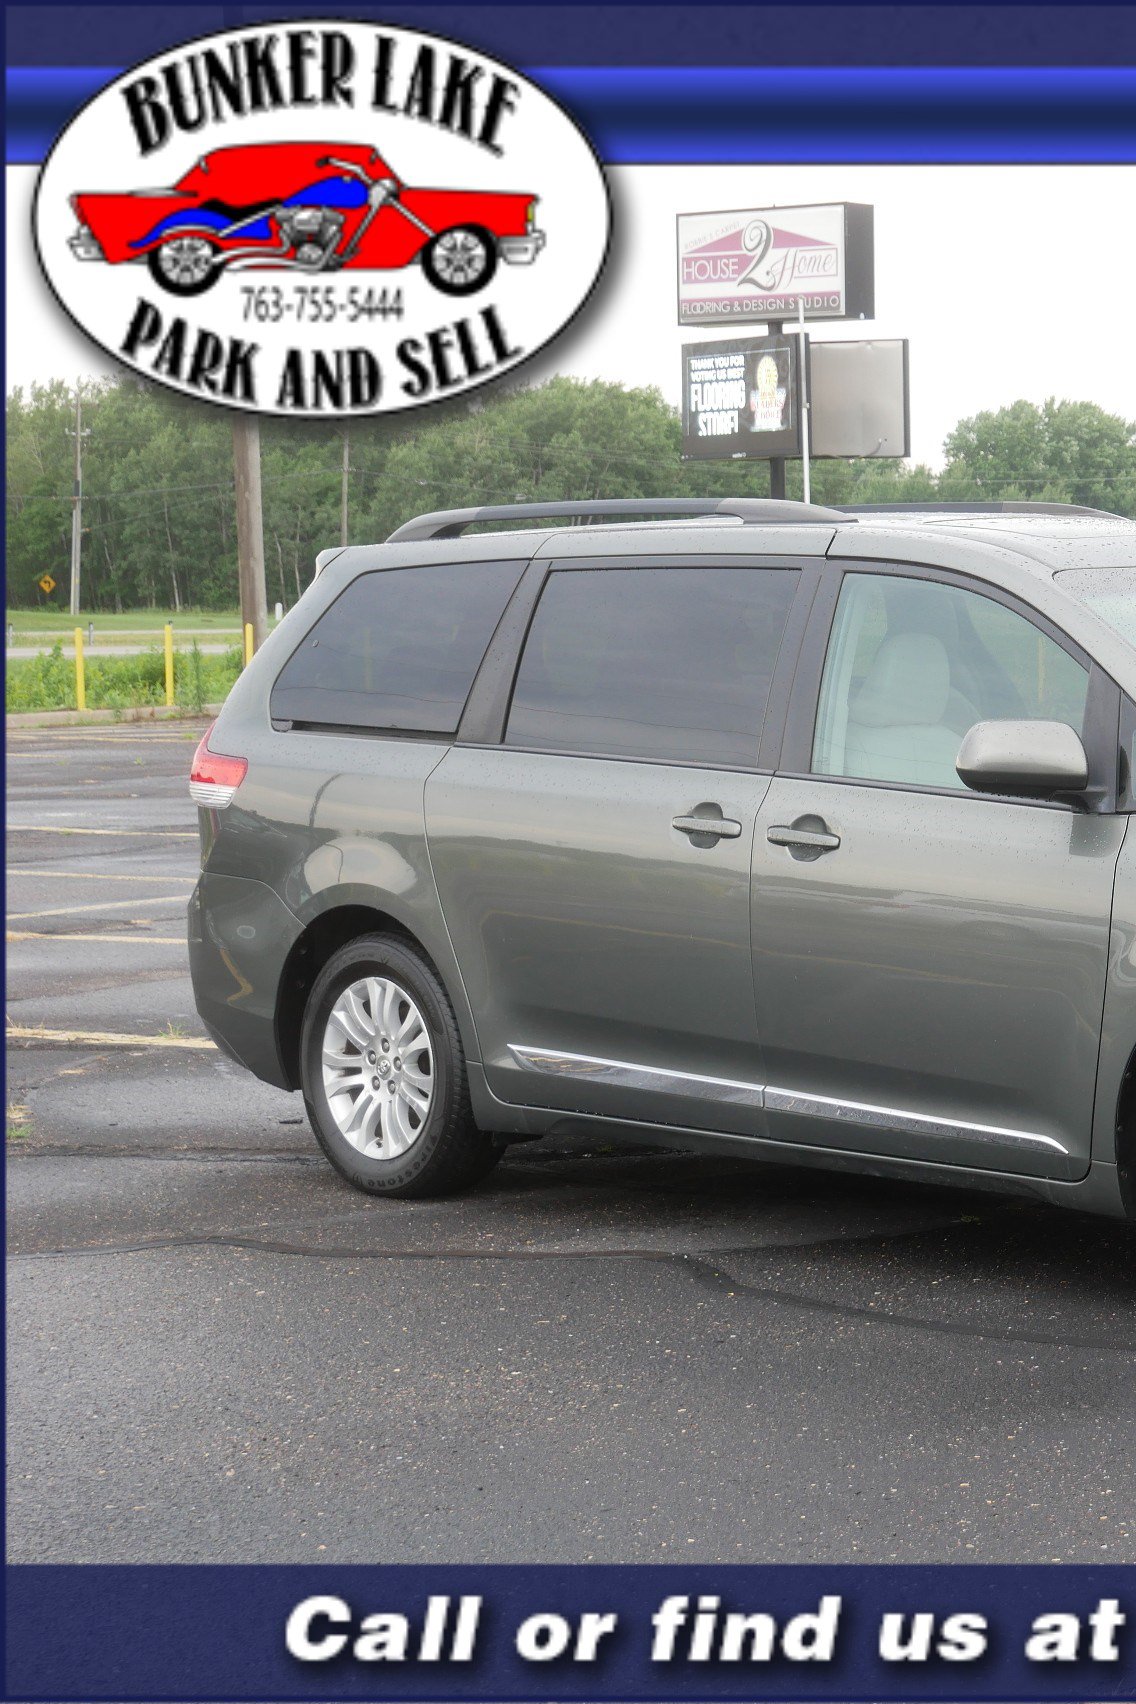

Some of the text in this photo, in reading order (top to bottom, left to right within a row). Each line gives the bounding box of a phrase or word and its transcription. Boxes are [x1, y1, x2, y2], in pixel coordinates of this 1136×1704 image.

[684, 220, 833, 292] HOUSE 2 Home
[682, 299, 731, 314] FLOORING
[733, 301, 741, 312] &
[743, 298, 785, 311] DESIGN
[715, 357, 729, 369] YOU
[691, 380, 746, 411] FLOORING
